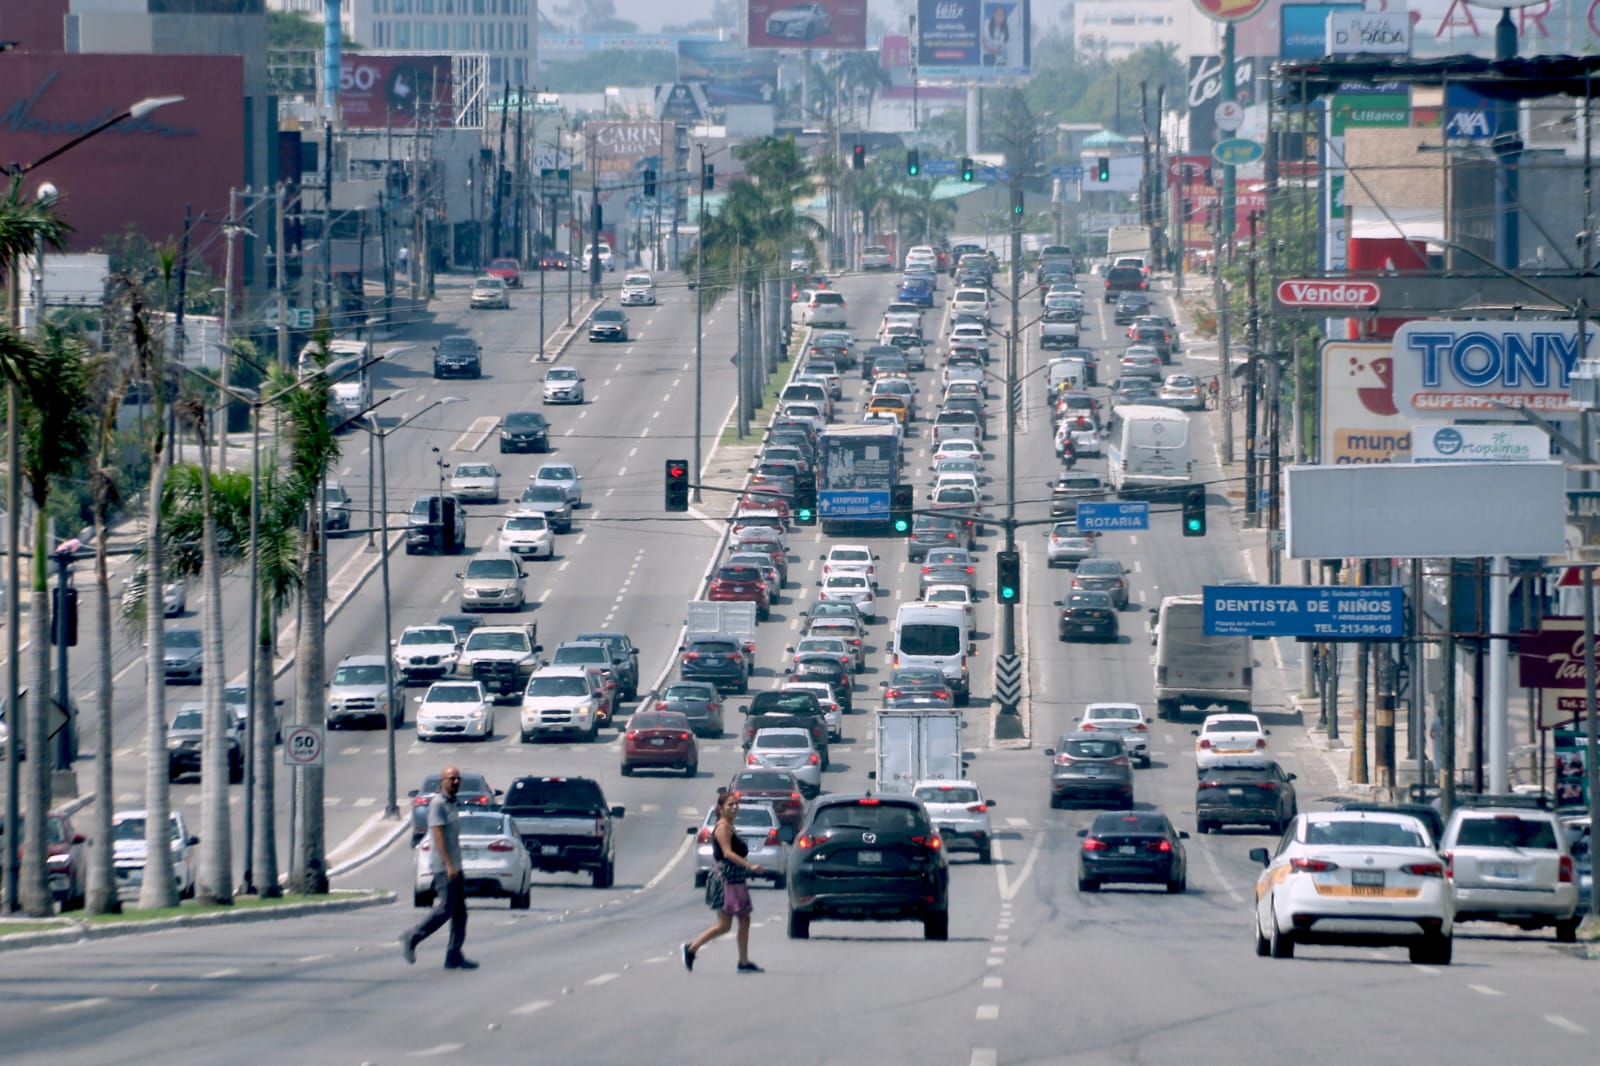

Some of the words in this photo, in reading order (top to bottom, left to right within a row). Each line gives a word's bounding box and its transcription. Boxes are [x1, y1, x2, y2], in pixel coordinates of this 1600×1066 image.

[1336, 30, 1405, 44] DRADA
[1447, 111, 1489, 135] AXA
[1290, 284, 1368, 301] Vendor
[1408, 331, 1595, 388] TONY
[1085, 517, 1142, 527] ROTARIA
[1215, 599, 1299, 613] DENTISTA
[1306, 600, 1330, 613] DE
[1338, 598, 1392, 613] NIÑOS
[1314, 624, 1338, 633] TEL.
[295, 735, 314, 748] 50
